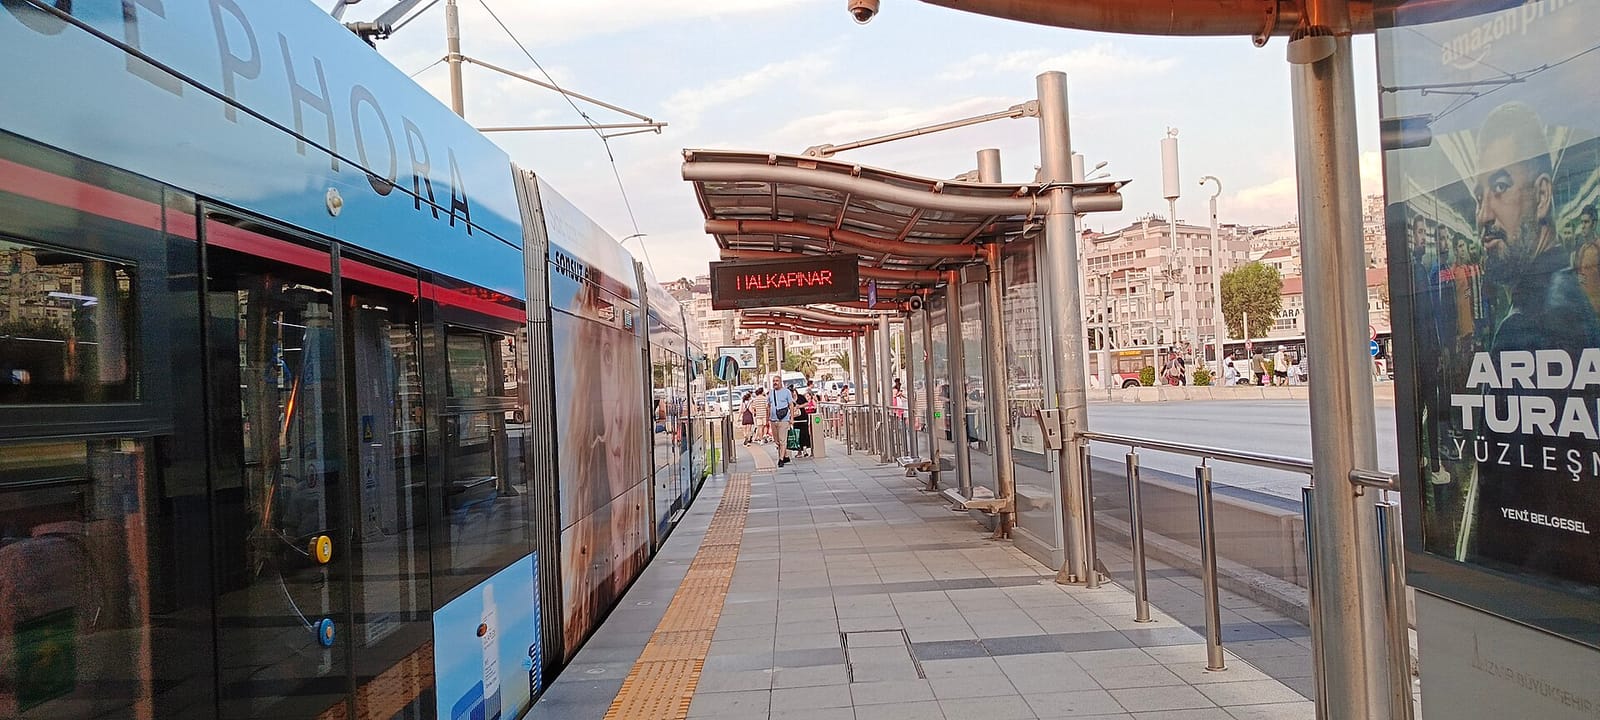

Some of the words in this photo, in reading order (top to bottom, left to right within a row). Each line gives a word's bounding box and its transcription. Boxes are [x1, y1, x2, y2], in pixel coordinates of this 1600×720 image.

[1441, 10, 1517, 66] amazon
[1466, 348, 1600, 390] ARDA
[1451, 394, 1600, 440] TURA
[1501, 507, 1529, 522] YENİ
[1530, 513, 1590, 534] BELGESEL
